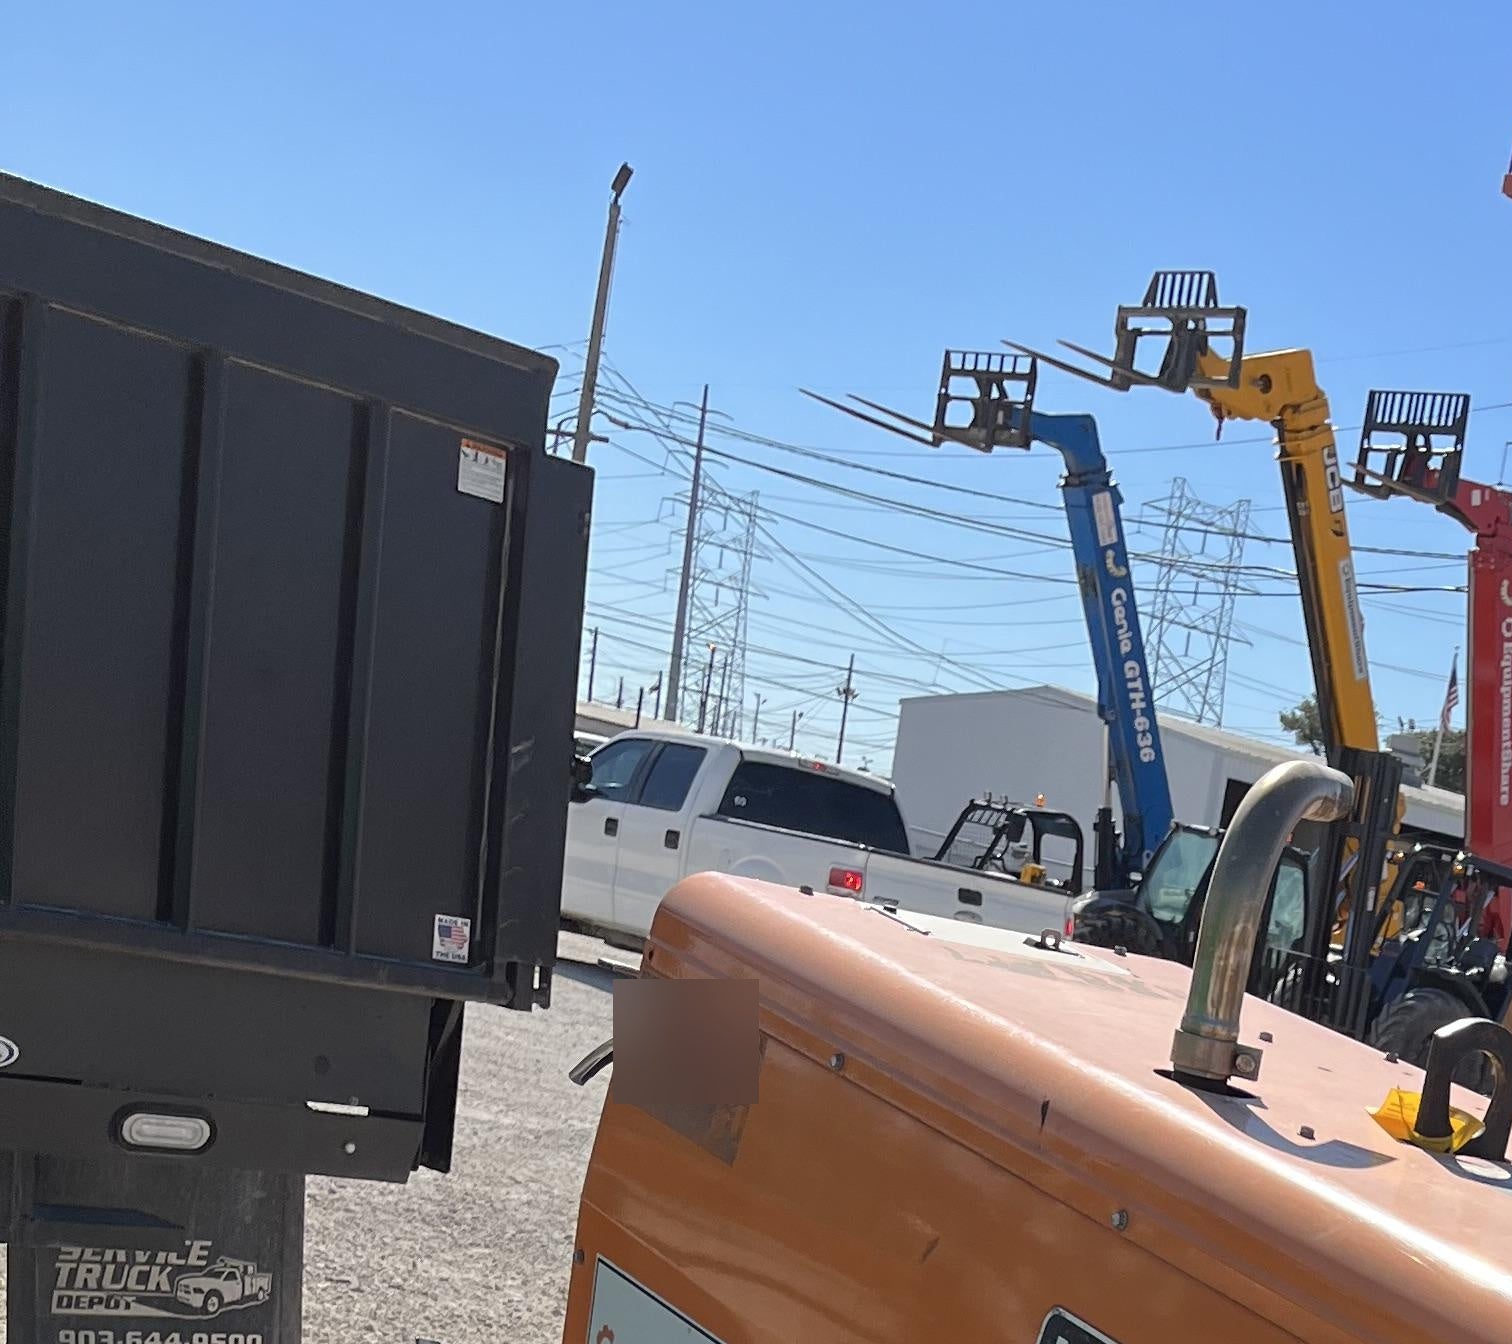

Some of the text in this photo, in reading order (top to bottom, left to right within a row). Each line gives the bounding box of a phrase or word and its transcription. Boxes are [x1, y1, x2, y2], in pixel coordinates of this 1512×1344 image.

[1323, 446, 1343, 513] JCB
[1111, 587, 1132, 656] Genie
[55, 1262, 172, 1292] TRUCK
[55, 1294, 137, 1311] DEPOT
